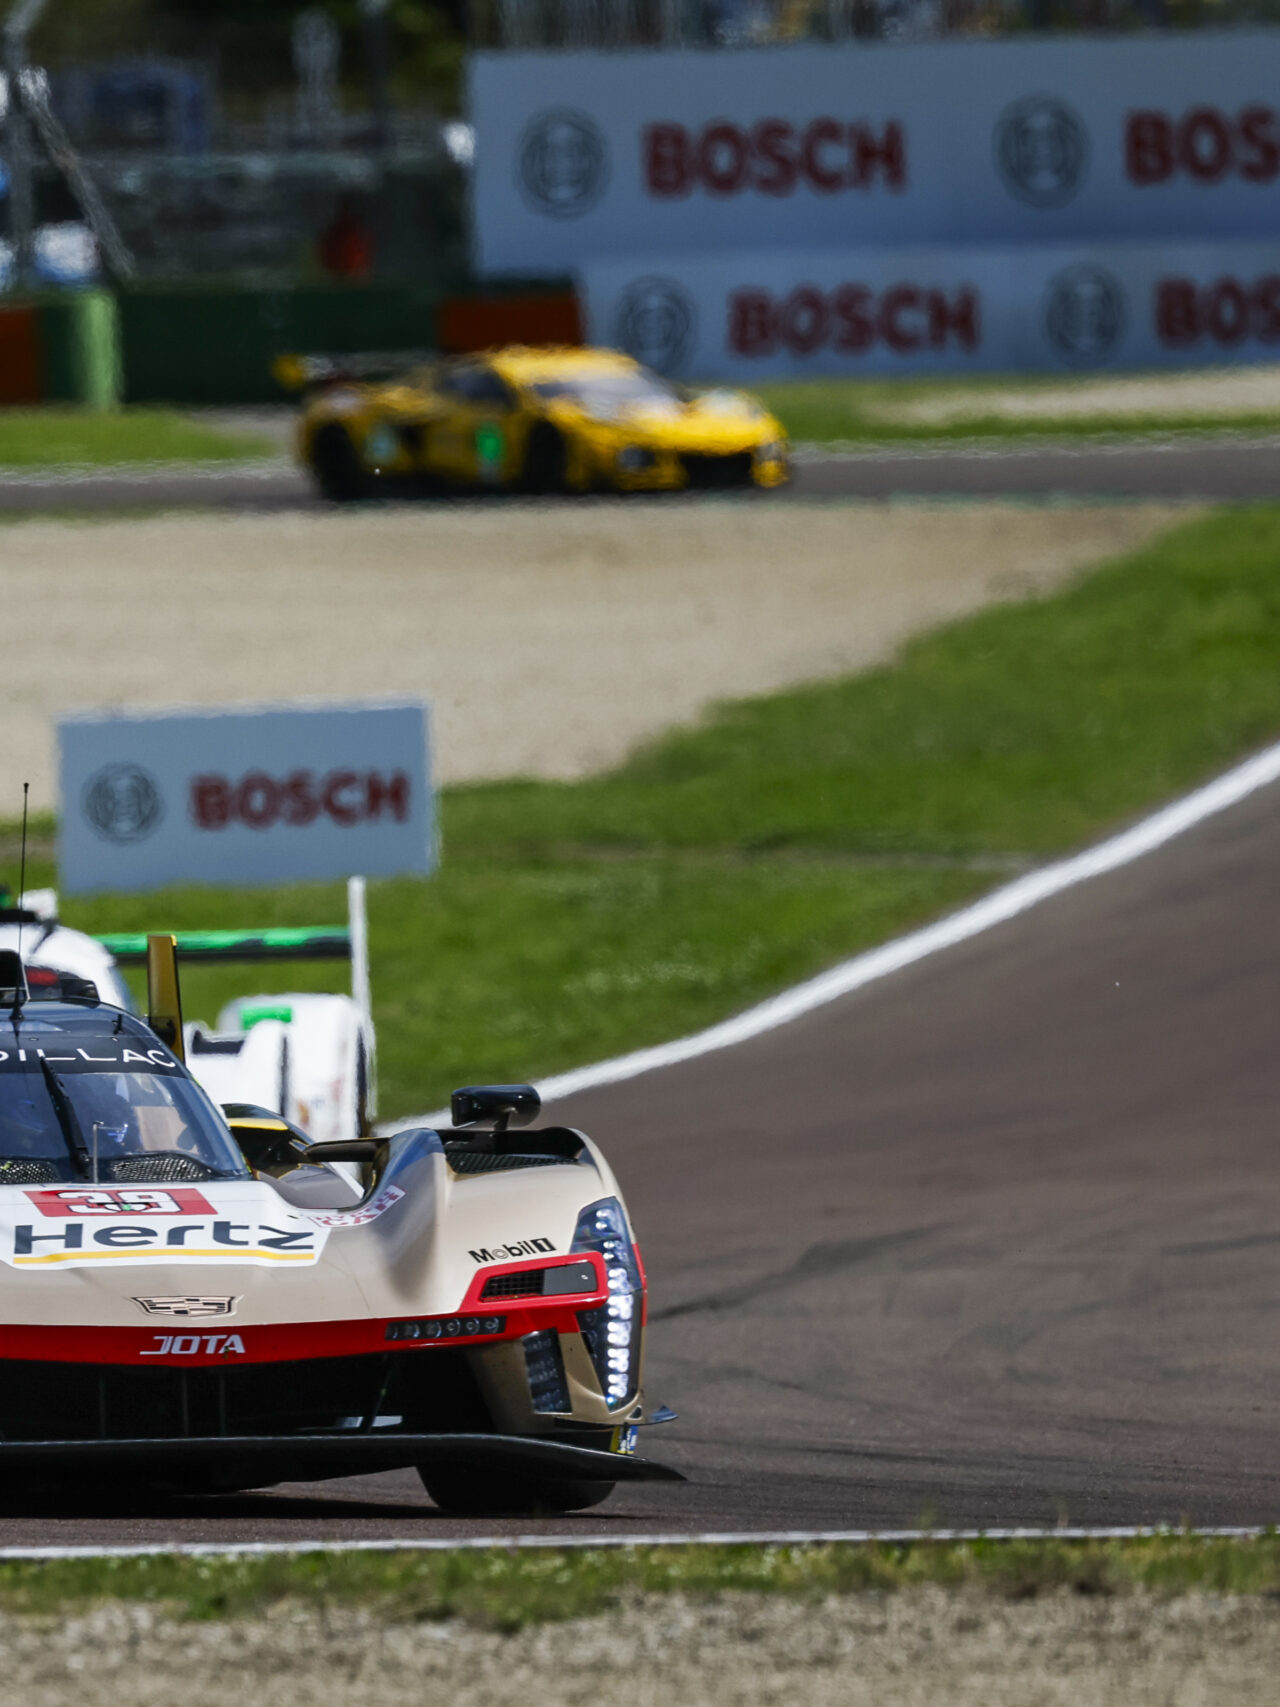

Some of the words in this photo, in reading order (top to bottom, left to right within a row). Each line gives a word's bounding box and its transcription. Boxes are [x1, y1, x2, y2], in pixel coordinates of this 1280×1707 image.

[644, 117, 907, 197] BOSCH
[729, 282, 980, 357] BOSCH
[191, 768, 410, 831] BOSCH
[14, 1220, 315, 1255] Hertz
[139, 1334, 246, 1355] JOTA
